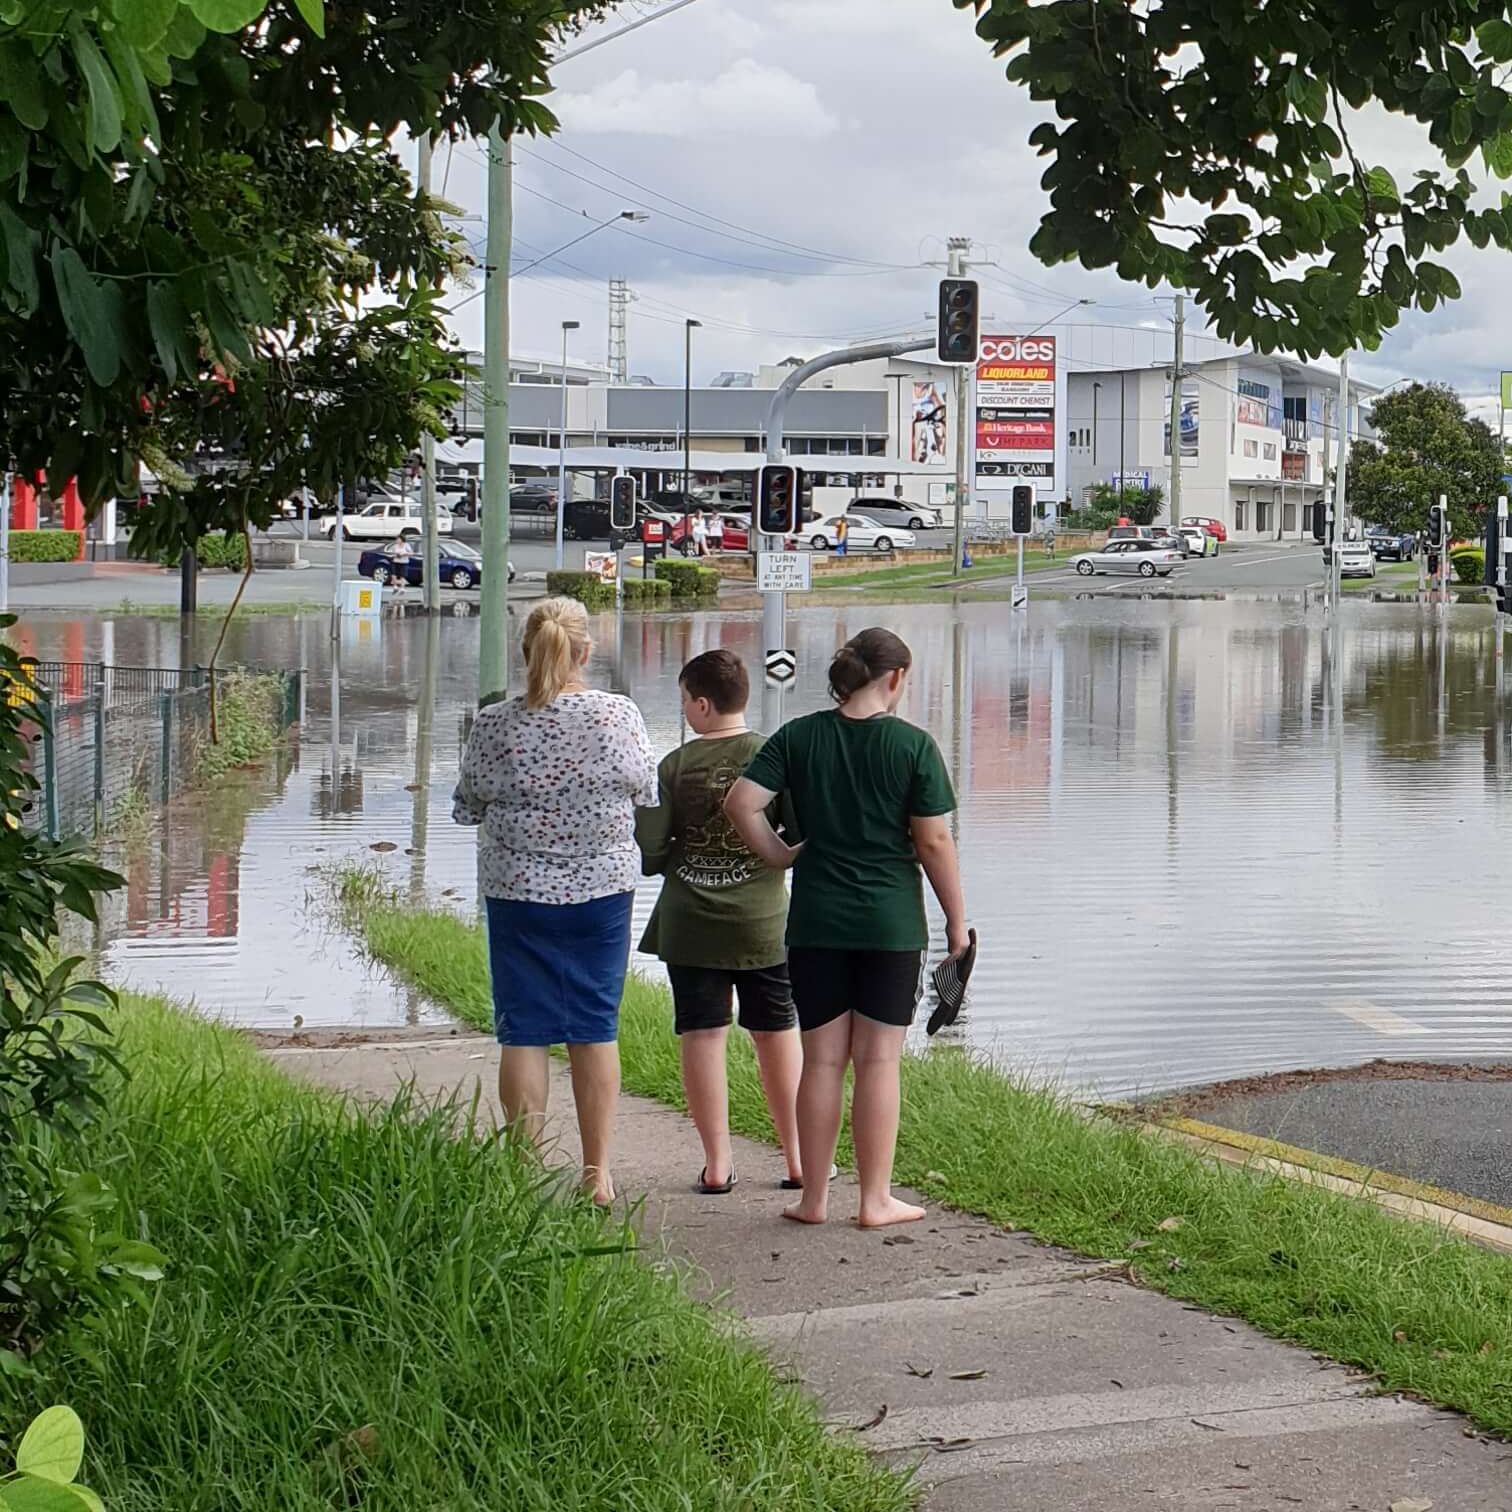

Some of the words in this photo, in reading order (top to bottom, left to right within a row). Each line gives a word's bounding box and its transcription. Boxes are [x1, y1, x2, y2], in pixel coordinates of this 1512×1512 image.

[981, 337, 1053, 361] coles
[982, 367, 1049, 379] LIQUORLAND
[981, 396, 1018, 405] DISCOUNT
[1019, 396, 1051, 405] CHEMIST
[769, 555, 797, 563] TURN
[769, 565, 794, 573] LEFT
[676, 865, 752, 887] GAMEFACE
